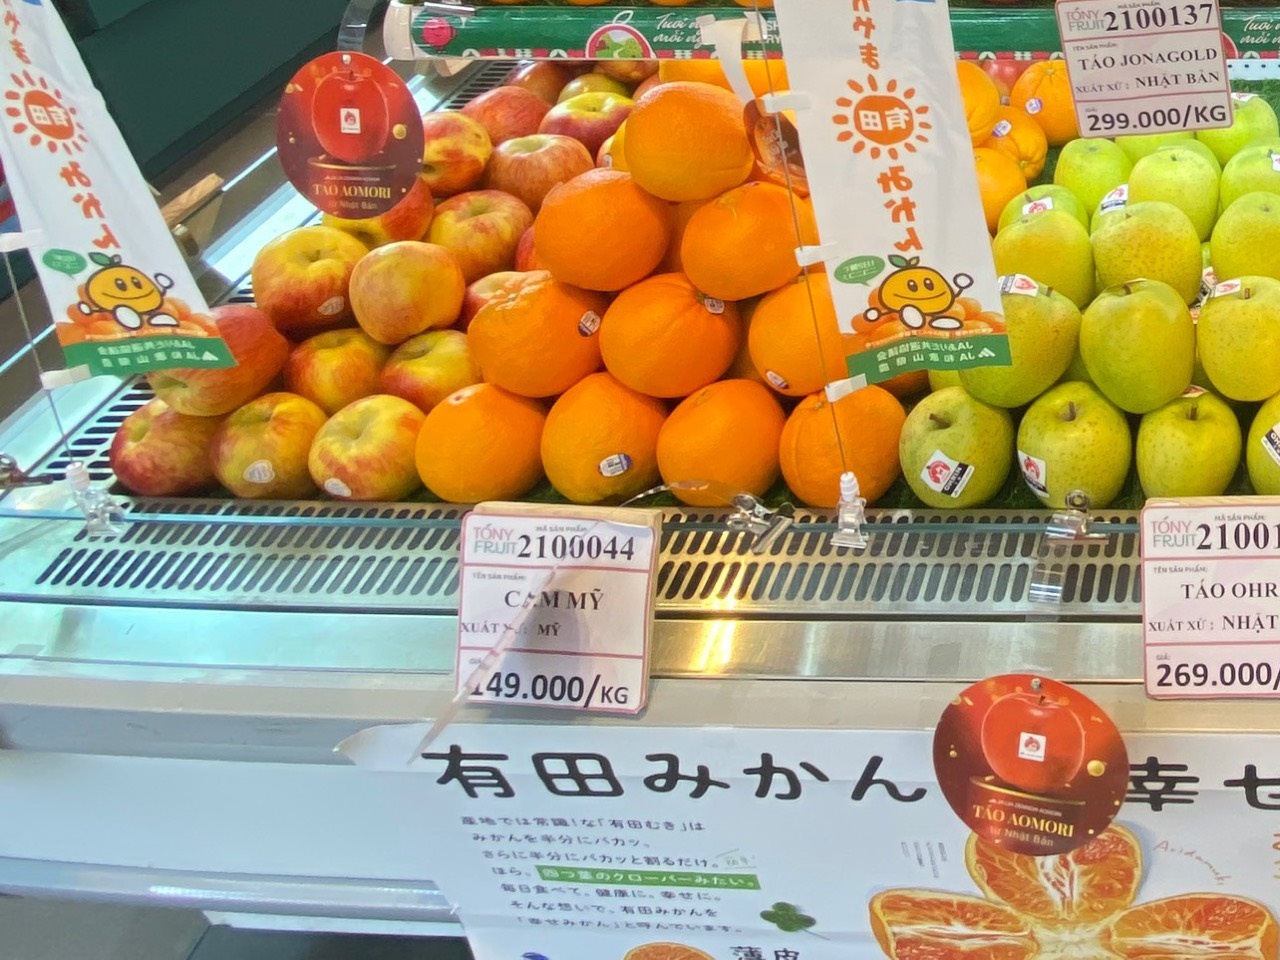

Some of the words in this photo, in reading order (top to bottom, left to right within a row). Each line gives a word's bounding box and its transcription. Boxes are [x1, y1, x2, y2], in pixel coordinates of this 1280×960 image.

[1068, 19, 1106, 32] FRUIT
[1104, 3, 1213, 32] 2100137
[1077, 54, 1115, 71] TÁO
[1120, 48, 1217, 67] JONAGOLD
[1087, 105, 1226, 131] 299.000/KG
[341, 184, 391, 198] AOMORI
[944, 467, 962, 490] OHRIN
[474, 540, 518, 554] FRUIT
[517, 534, 634, 561] 2100044
[1153, 534, 1198, 548] FRUIT
[566, 588, 604, 611] MỸ
[1180, 578, 1225, 599] TÁO
[537, 622, 561, 637] MỸ
[1222, 613, 1278, 633] NHẬT
[1008, 814, 1075, 838] AOMORI
